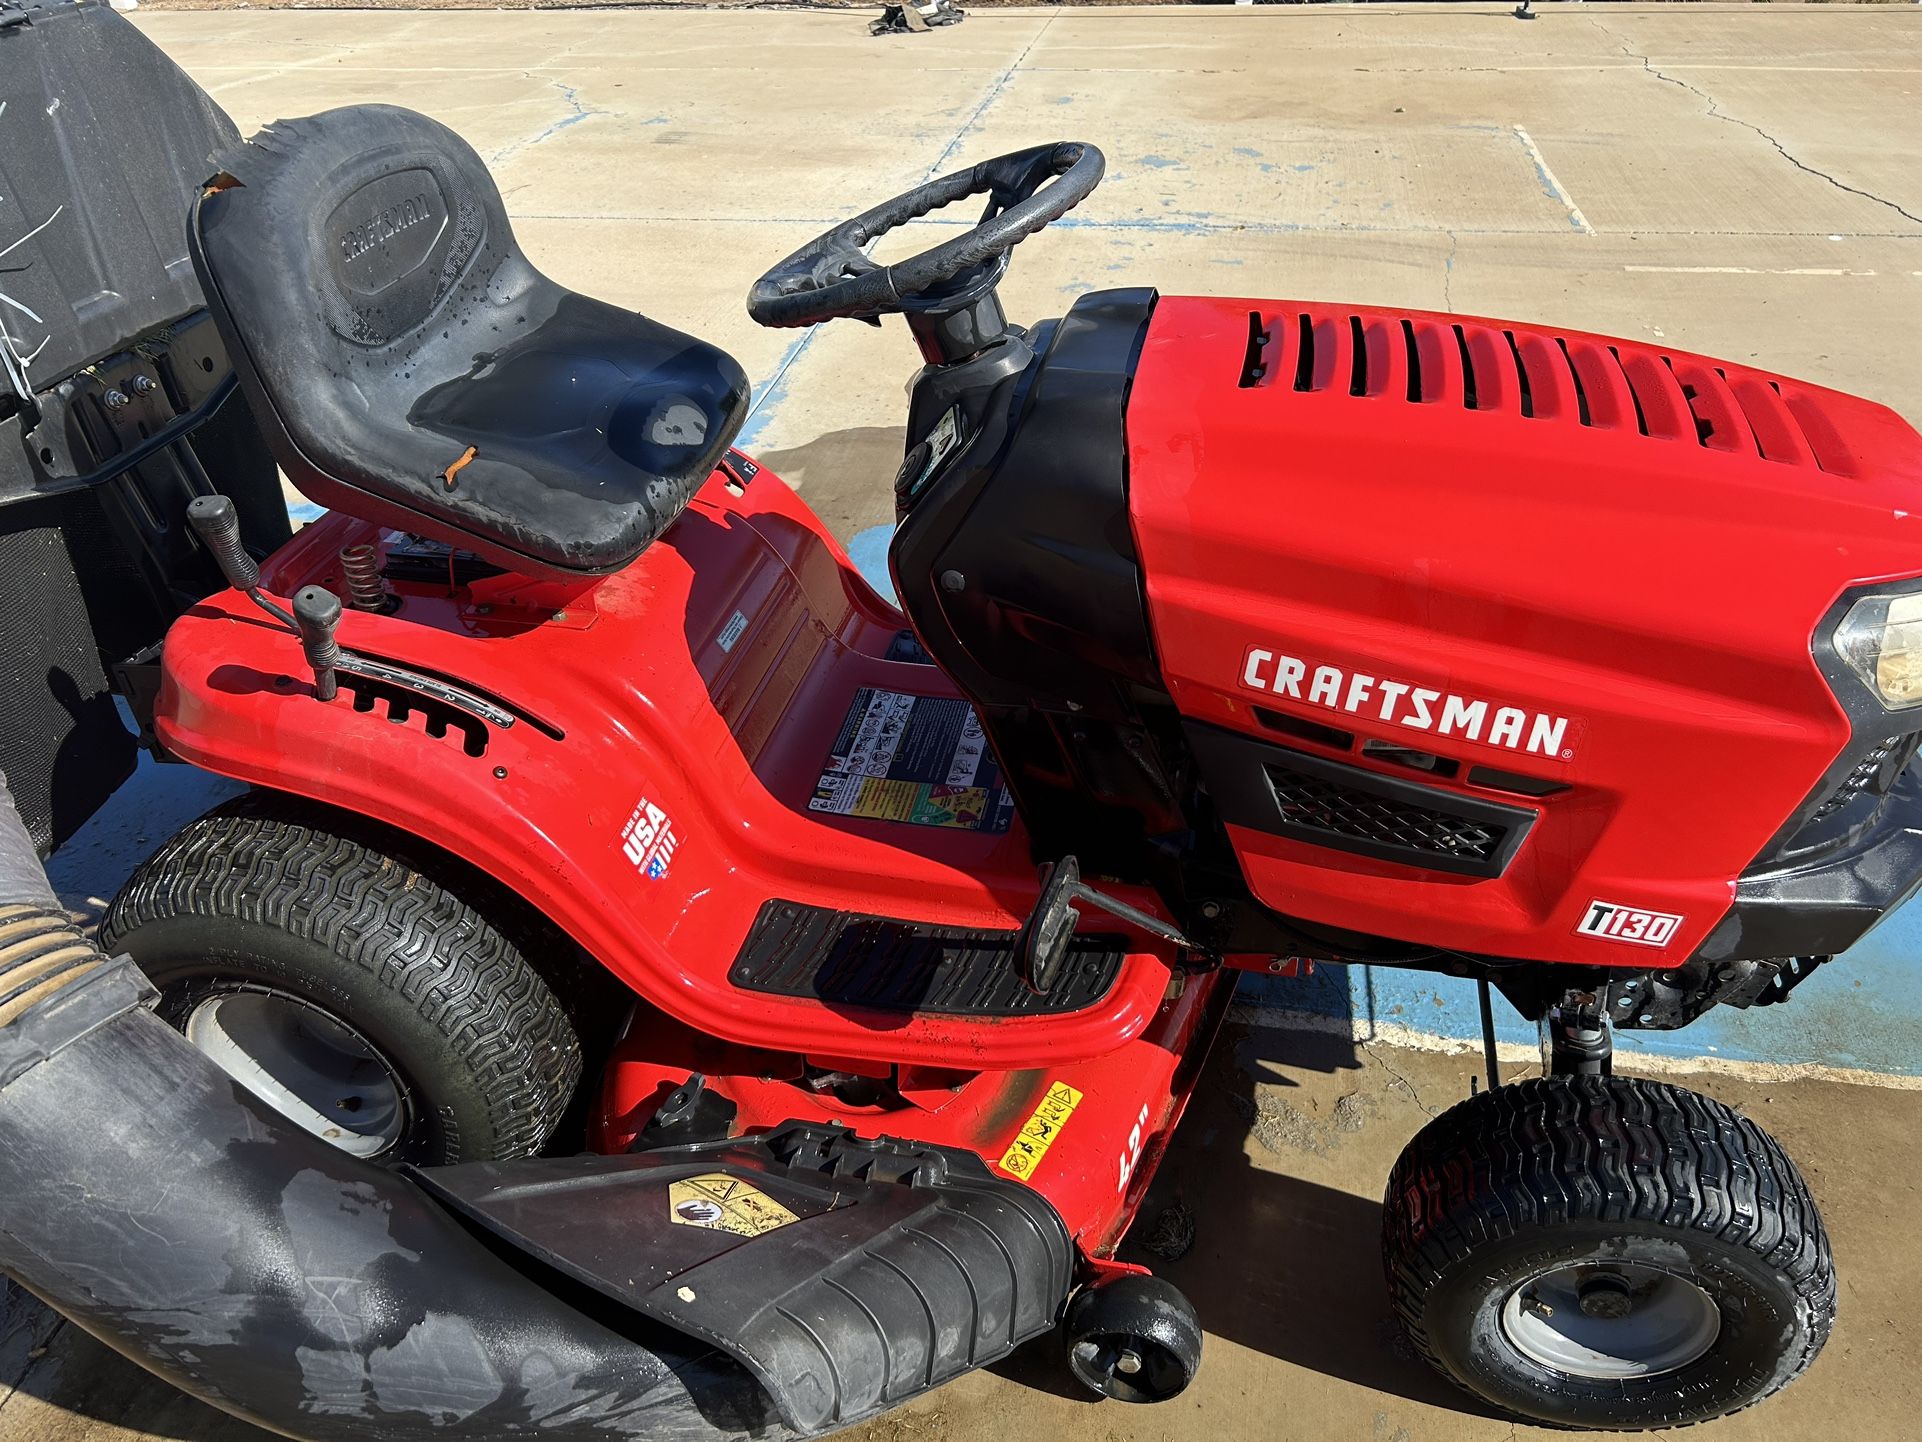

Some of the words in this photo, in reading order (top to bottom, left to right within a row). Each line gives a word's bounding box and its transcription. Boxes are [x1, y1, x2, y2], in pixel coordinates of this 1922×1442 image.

[340, 193, 431, 263] CRAFTSMAN
[1244, 648, 1569, 757] CRAFTSMAN
[620, 817, 636, 839] MADE
[632, 809, 641, 821] IN
[637, 796, 648, 811] THE
[622, 802, 667, 866] USA
[1588, 904, 1675, 942] T130
